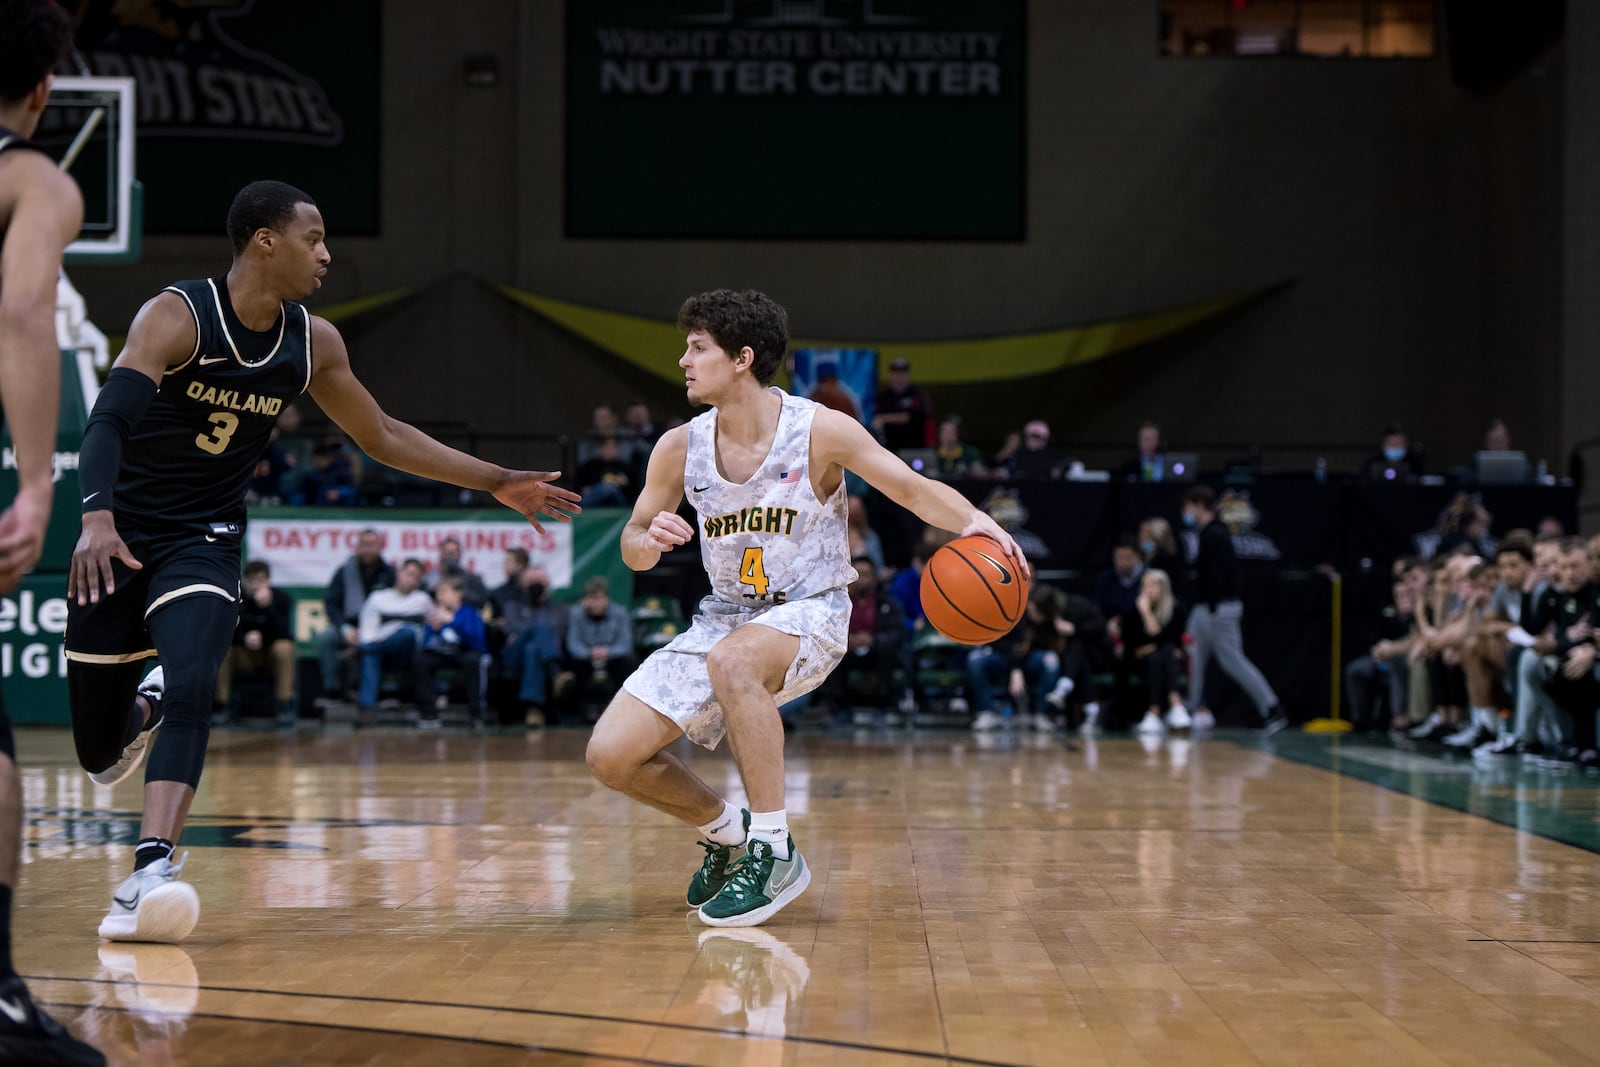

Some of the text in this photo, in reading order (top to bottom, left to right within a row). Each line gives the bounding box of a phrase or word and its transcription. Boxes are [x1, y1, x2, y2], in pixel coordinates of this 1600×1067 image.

[597, 28, 1001, 60] WRIGHT STATE UNIVERSITY
[600, 59, 1001, 97] NUTTER CENTER
[196, 65, 333, 134] STATE
[185, 380, 283, 417] OAKLAND
[194, 411, 240, 456] 3
[401, 530, 556, 552] BUINESS
[704, 506, 798, 539] WRIGHT
[739, 546, 770, 595] 4
